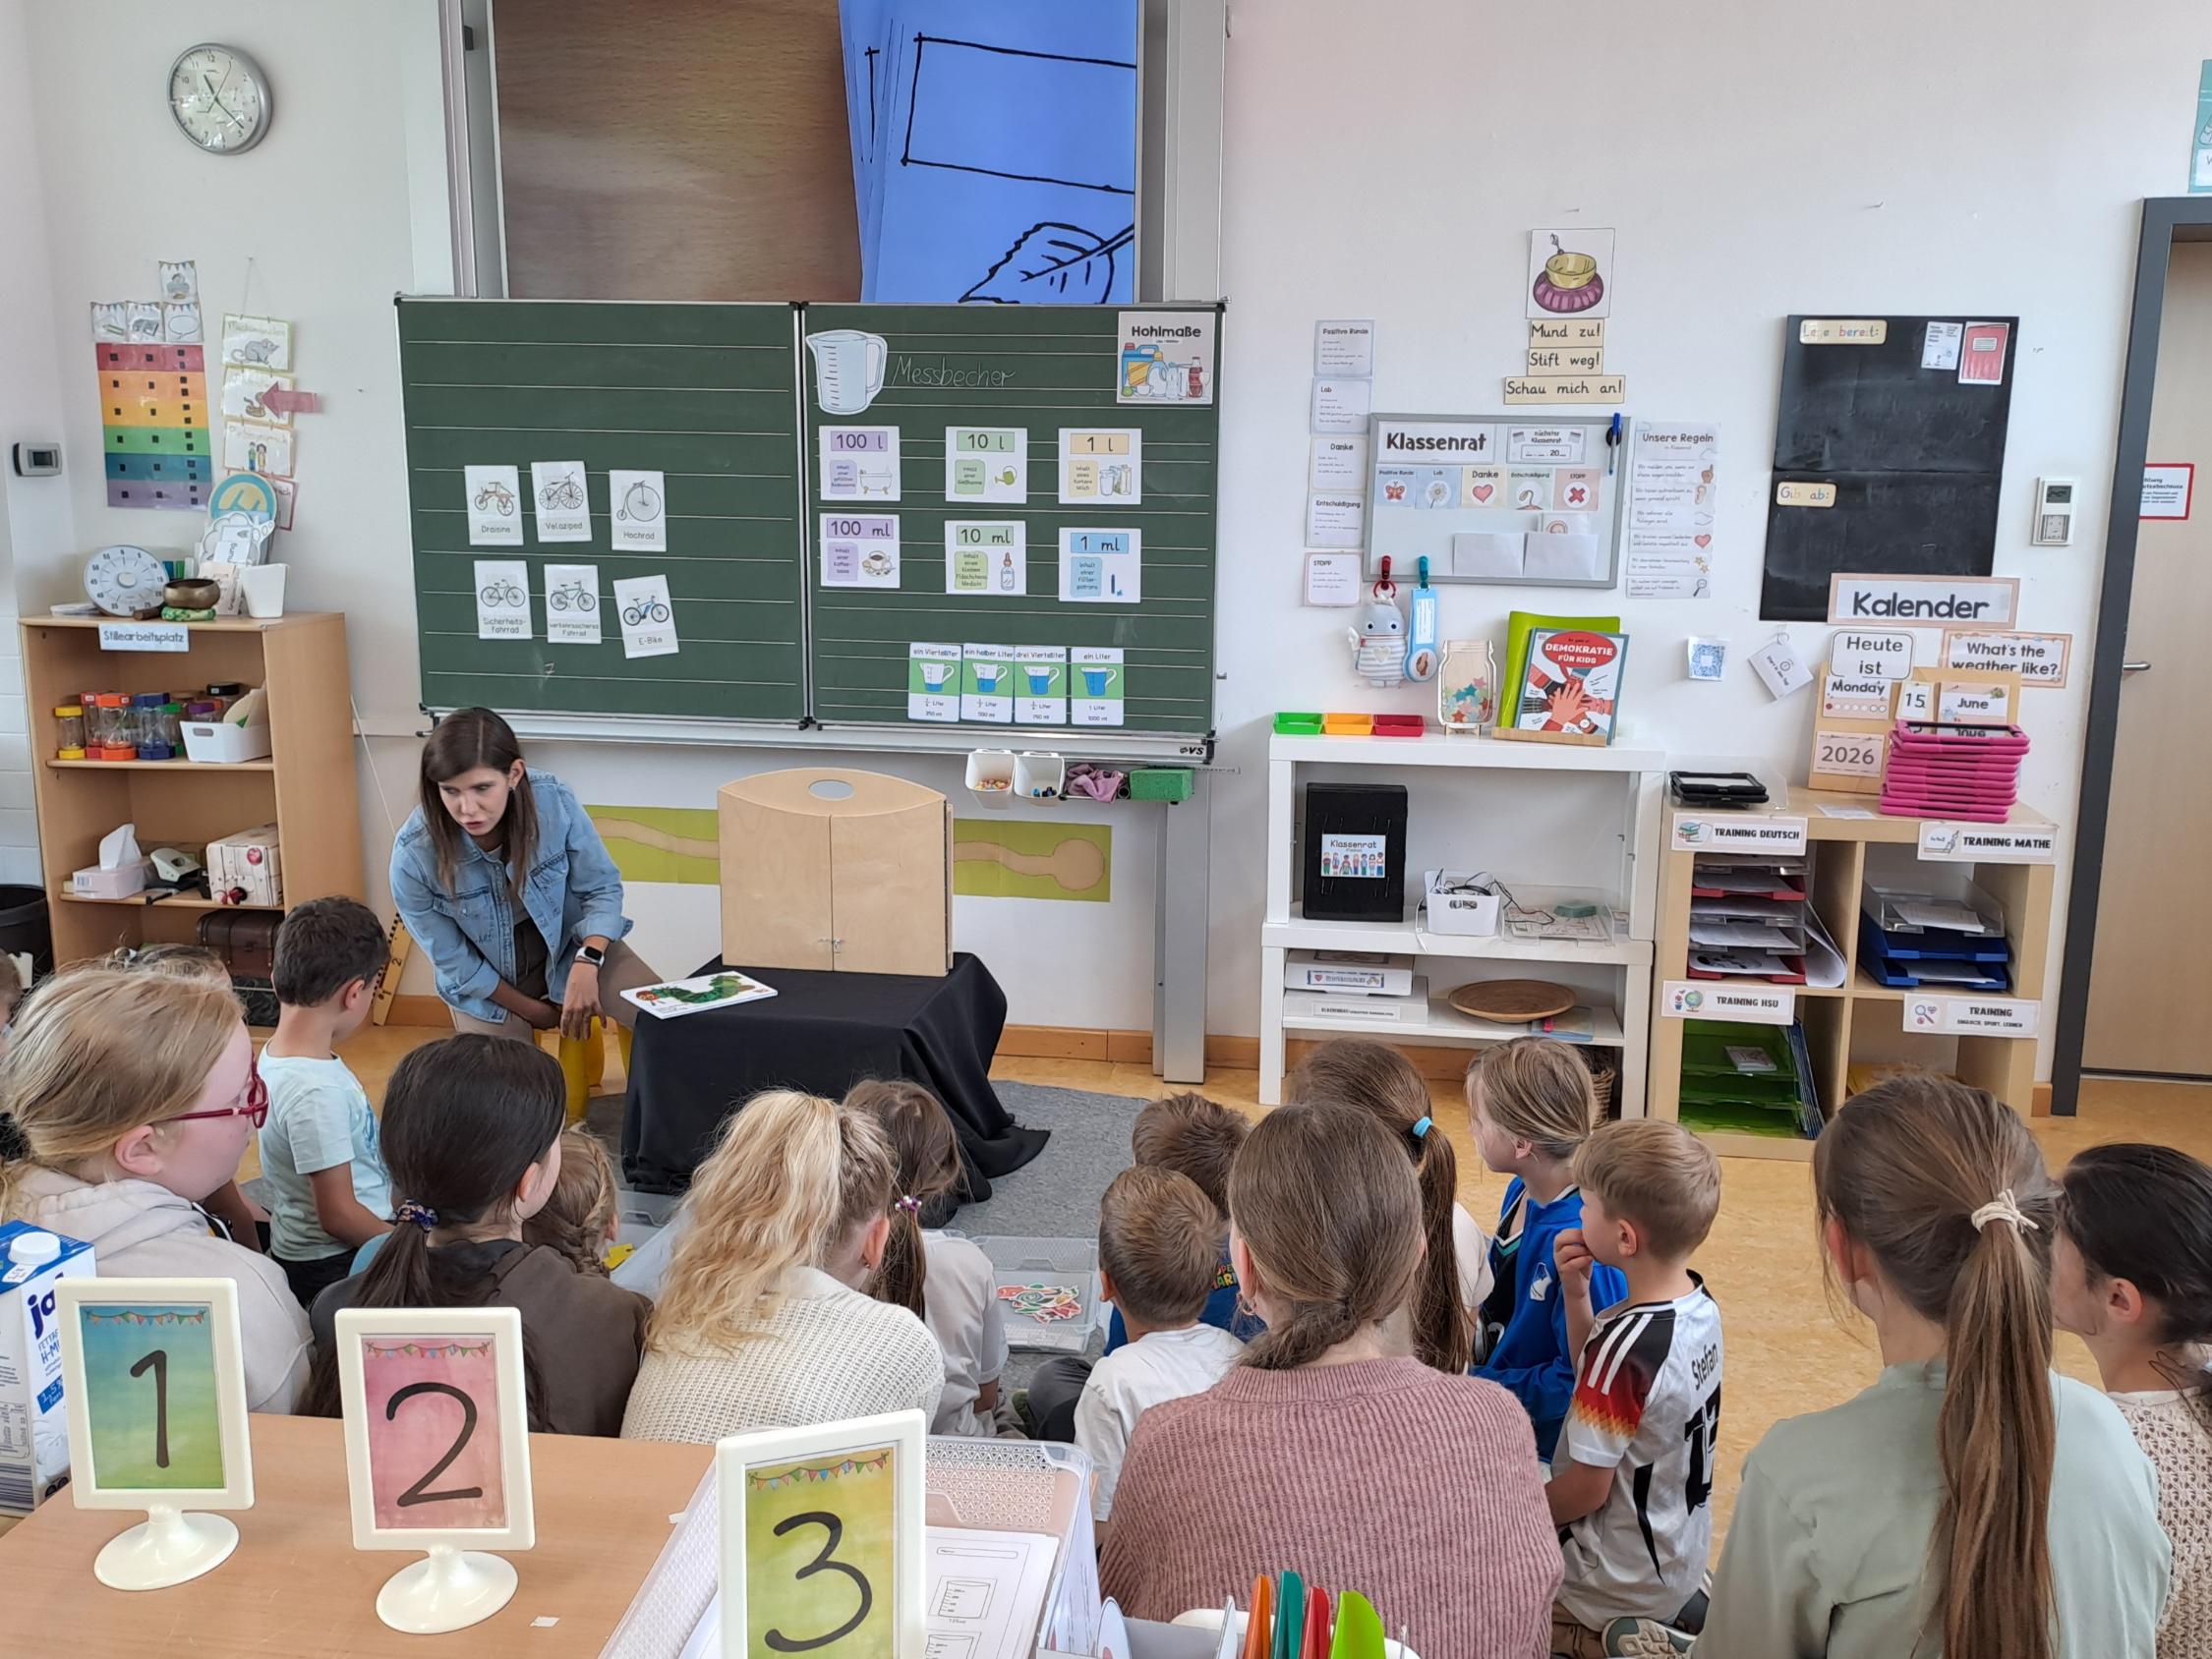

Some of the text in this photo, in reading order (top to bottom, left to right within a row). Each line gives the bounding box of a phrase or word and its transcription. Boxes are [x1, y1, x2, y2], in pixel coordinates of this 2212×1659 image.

[1132, 325, 1201, 337] Hohlmaße
[1531, 323, 1601, 339] Mund zu!
[1804, 324, 1830, 337] Lee
[1529, 352, 1601, 370] Stift weg!
[892, 356, 1016, 388] Messbecher
[1506, 379, 1622, 396] Schau mich an!
[837, 433, 867, 449] 100
[967, 433, 988, 449] 10
[1087, 436, 1094, 452] 1
[1387, 432, 1486, 451] Klassenrat
[1643, 433, 1714, 443] Unsere Regeln
[1315, 500, 1361, 509] Entschuldigung
[622, 532, 655, 541] Hochrad
[831, 520, 892, 537] 100 ml
[960, 528, 1011, 543] 10 ml
[1080, 536, 1120, 551] 1 ml
[1852, 591, 1990, 620] Kalender
[103, 628, 185, 645] Stillearbeitsplatz
[1846, 636, 1903, 653] Heute
[1545, 643, 1613, 656] DEMOKRATIE
[1967, 642, 2045, 658] What's the
[1859, 660, 1882, 675] ist
[1951, 659, 2059, 675] weather like?
[1832, 679, 1885, 697] Monday
[1905, 692, 1926, 709] 15
[1957, 697, 1989, 710] June
[1821, 745, 1875, 765] 2026
[1715, 828, 1799, 839] TRAINING DEUTSCH
[1331, 839, 1376, 848] Klassenrat
[1963, 836, 2051, 849] TRAINING MATHE
[1717, 997, 1758, 1006] TRAINING
[1969, 1006, 2012, 1016] TRAINING
[1692, 1342, 1717, 1392] Stefan
[130, 1349, 170, 1468] 1
[385, 1382, 484, 1508] 2
[764, 1511, 873, 1653] 3
